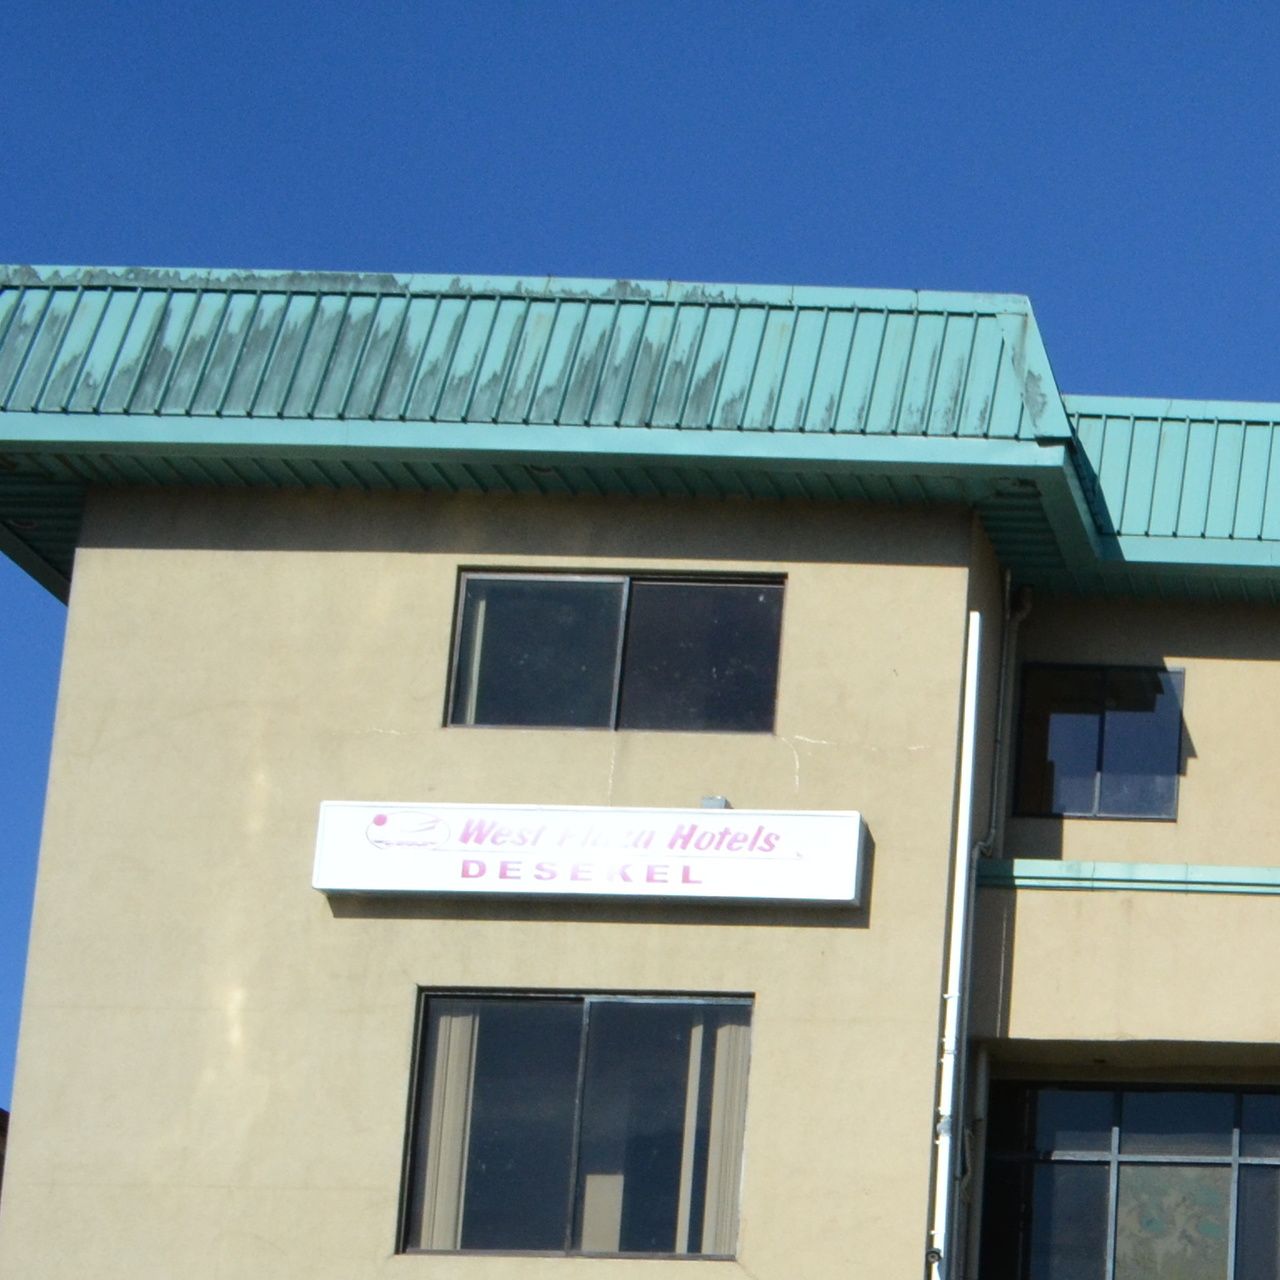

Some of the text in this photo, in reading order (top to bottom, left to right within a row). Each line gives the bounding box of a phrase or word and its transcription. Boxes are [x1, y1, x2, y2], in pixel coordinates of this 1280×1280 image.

[458, 818, 547, 847] West
[667, 823, 781, 852] Hotels
[460, 859, 703, 884] DESEKEL
